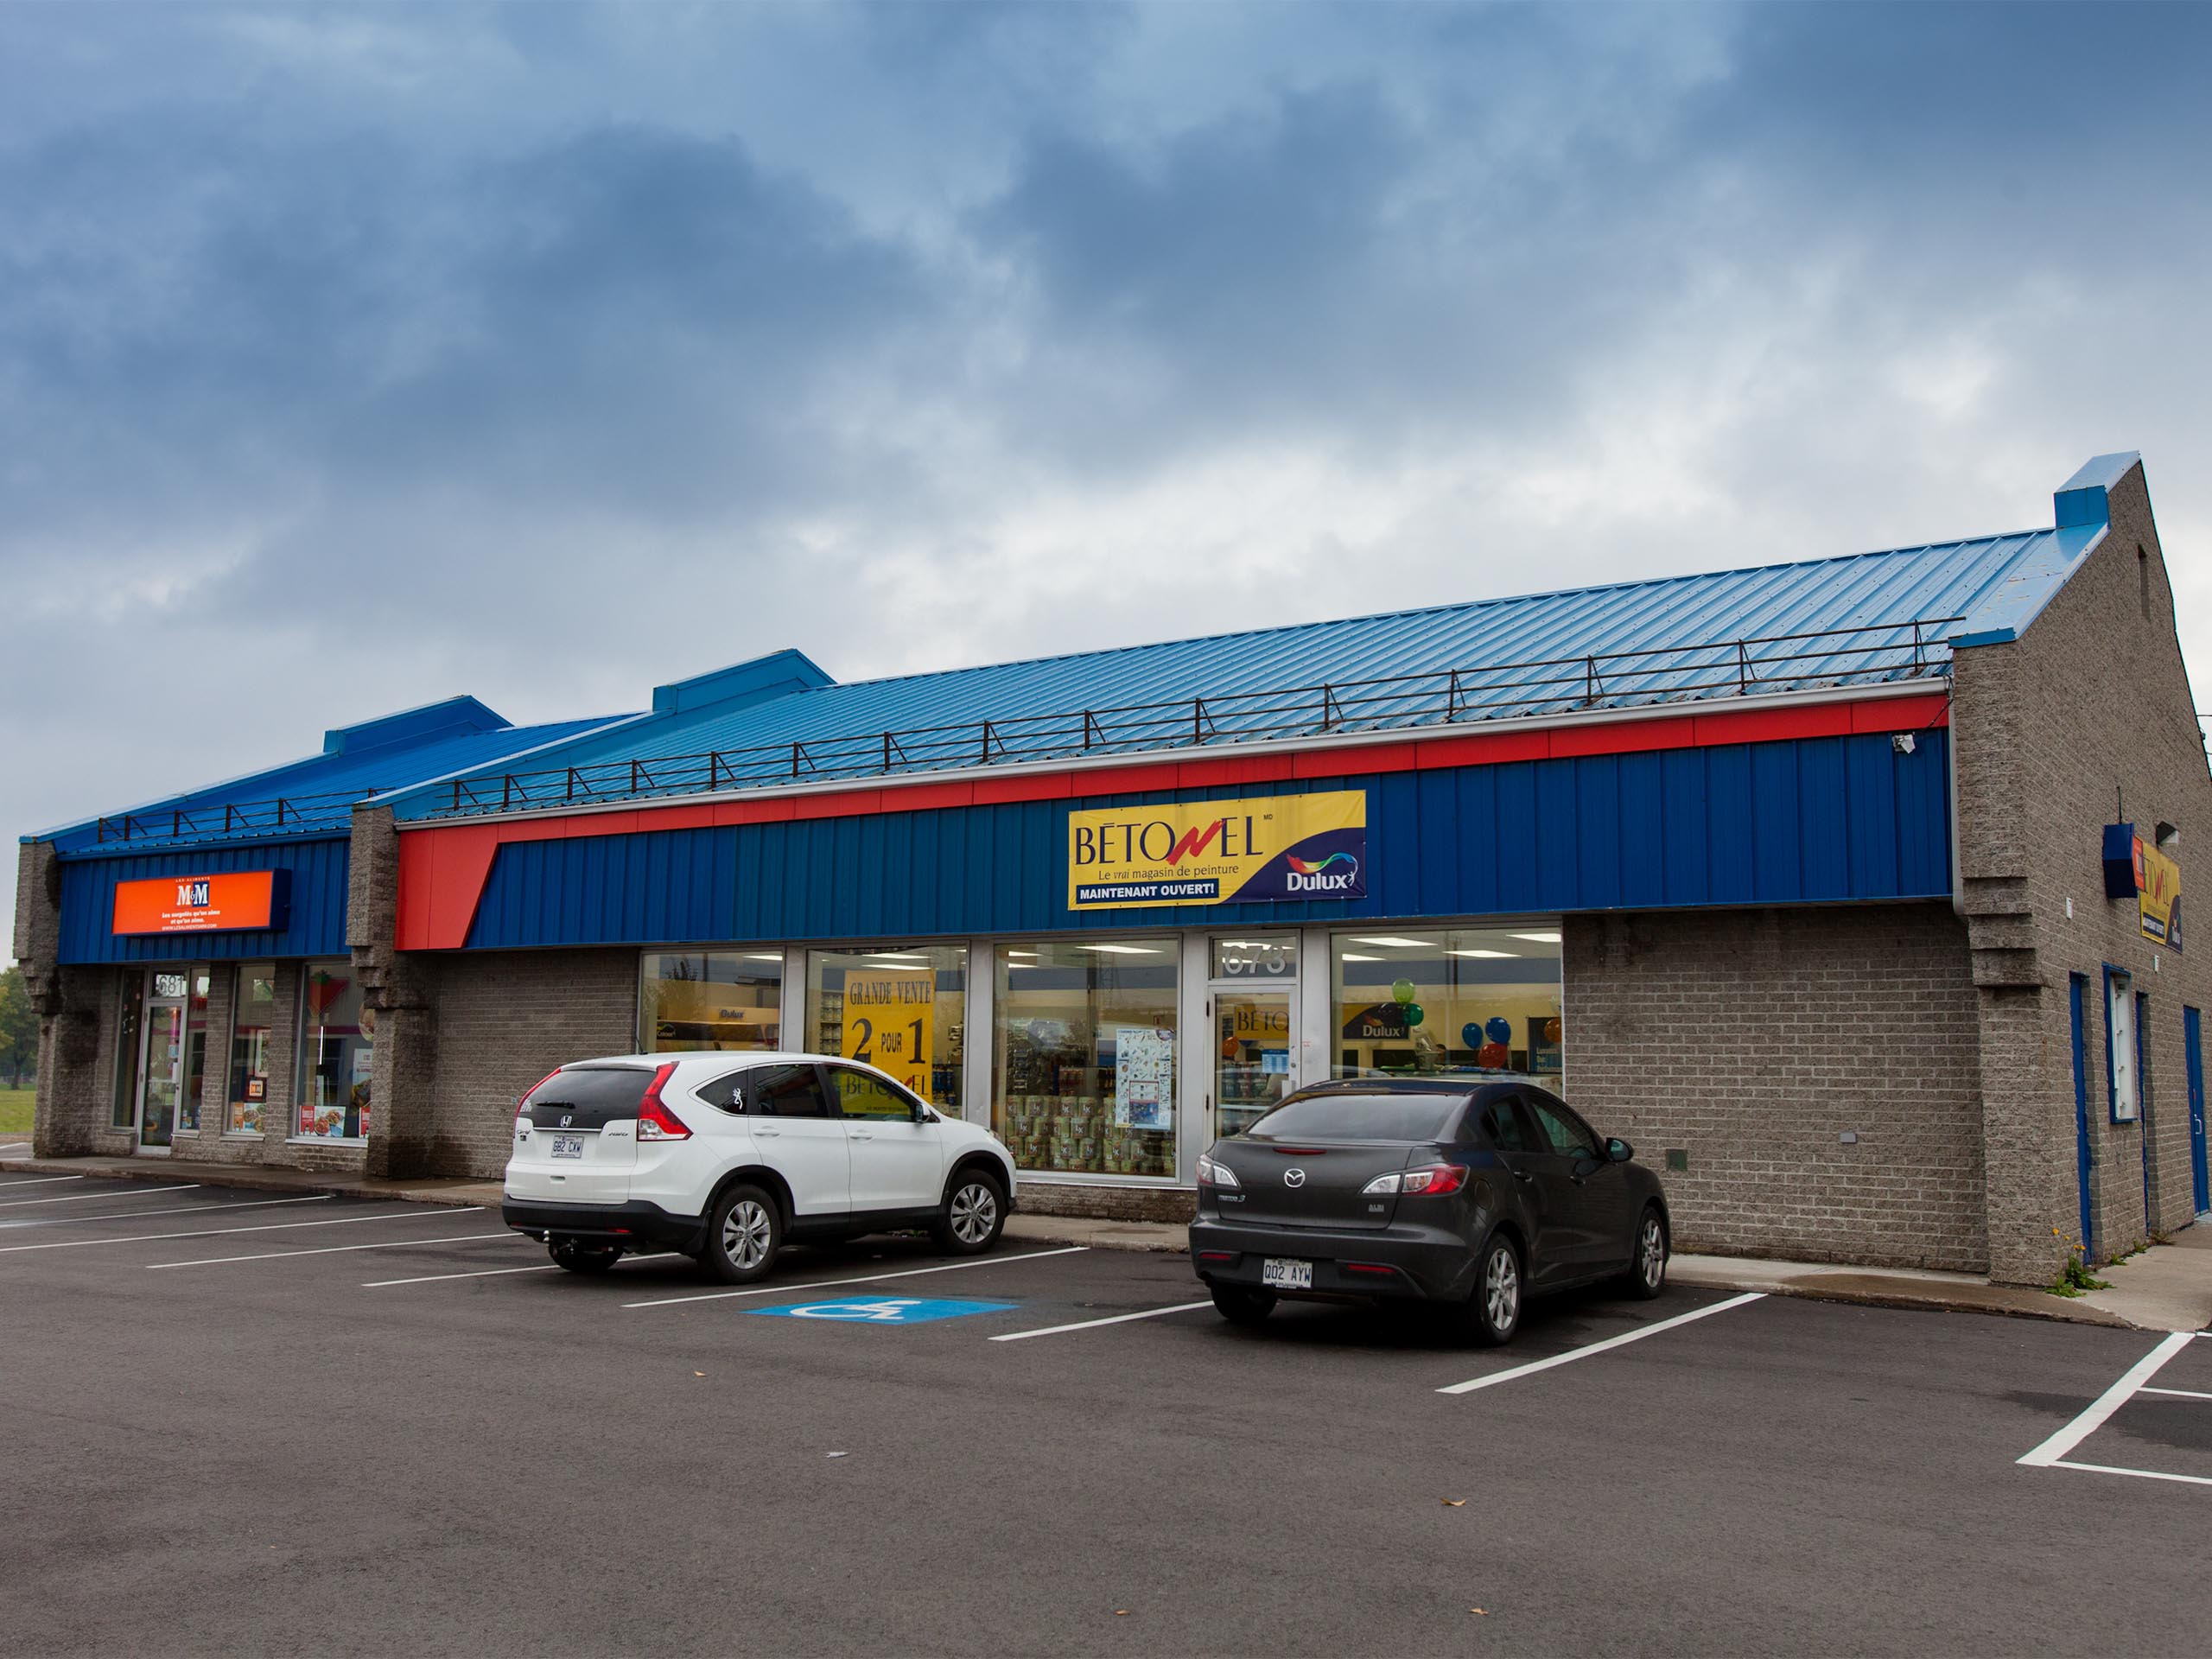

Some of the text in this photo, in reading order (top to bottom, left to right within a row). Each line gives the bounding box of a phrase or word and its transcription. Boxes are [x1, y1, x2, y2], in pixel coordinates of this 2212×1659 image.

[1098, 864, 1240, 880] Le vrai magasin de peinture
[1287, 872, 1349, 892] Dulux
[176, 883, 209, 906] M&M
[1079, 883, 1215, 900] MAINTENANT OUVERT!
[1224, 945, 1287, 975] 673
[158, 975, 184, 995] 681
[849, 981, 931, 1006] GRANDE VENTE
[851, 1017, 926, 1065] 2 POUR 1
[1363, 1025, 1401, 1038] Dulux
[1291, 1267, 1312, 1282] AYW
